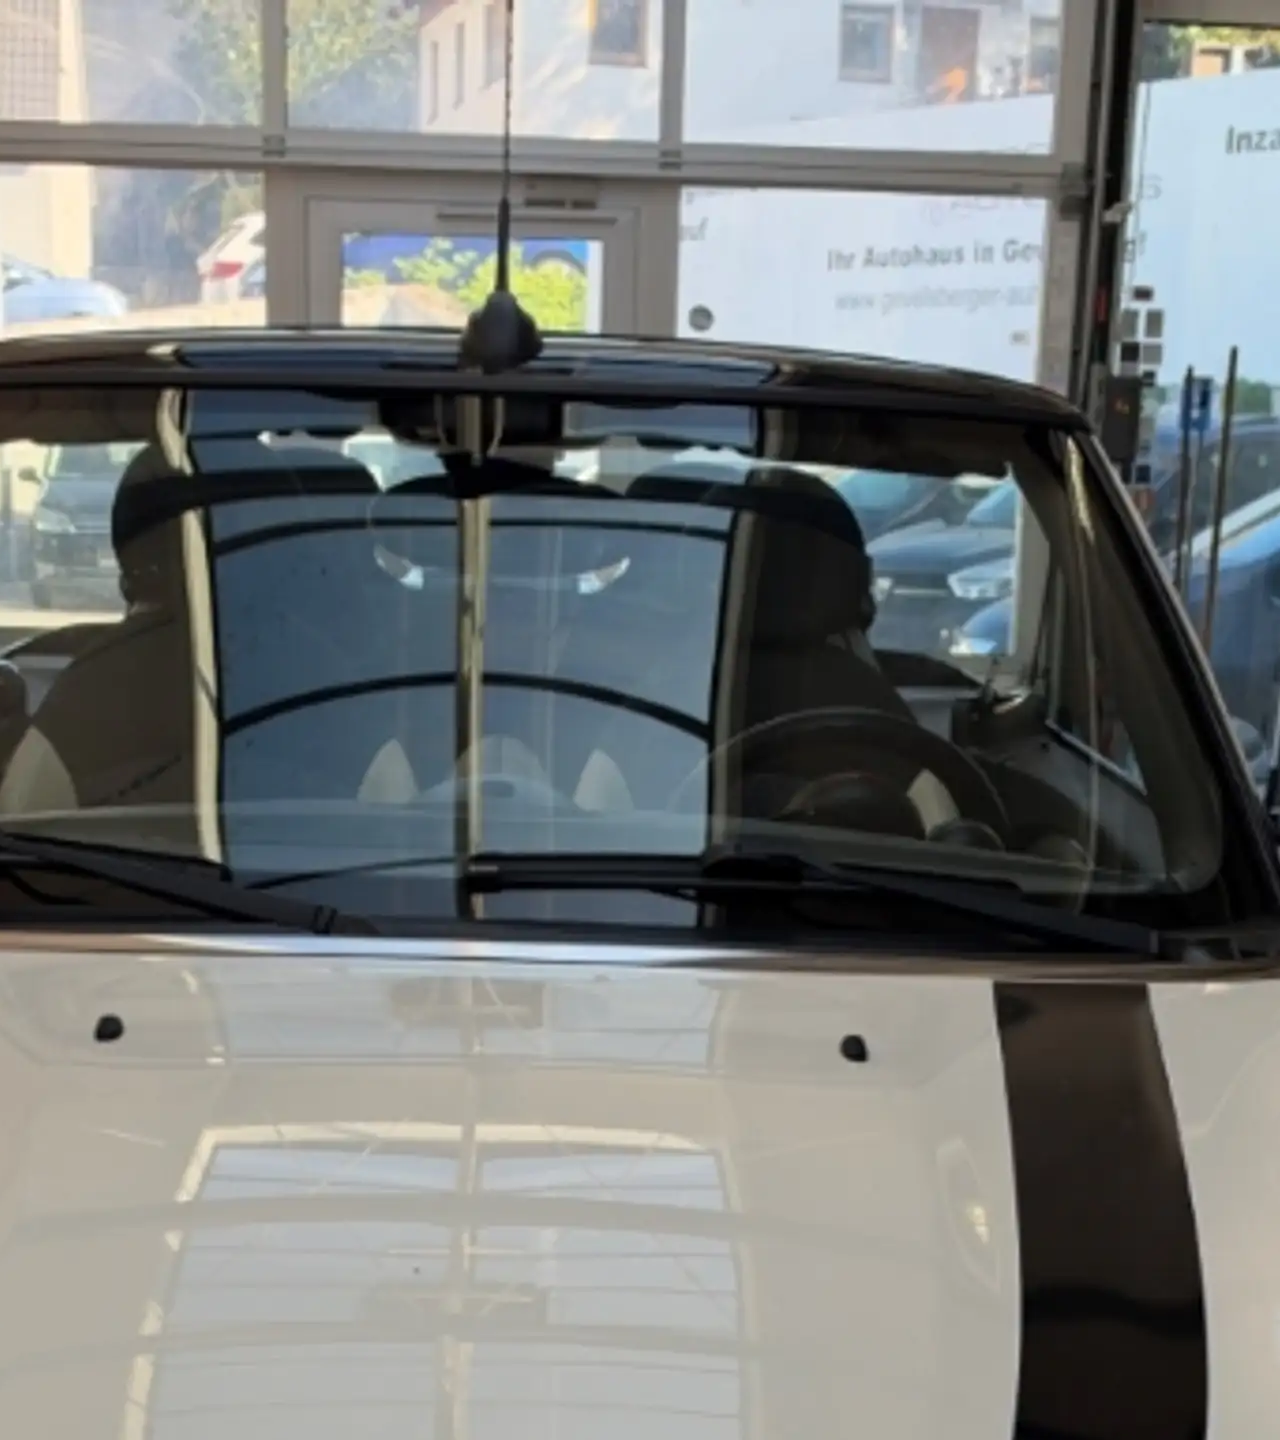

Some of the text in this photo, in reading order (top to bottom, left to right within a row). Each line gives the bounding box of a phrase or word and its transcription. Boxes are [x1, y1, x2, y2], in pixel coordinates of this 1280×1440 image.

[827, 248, 856, 271] Ihr
[862, 245, 965, 269] Autohaus
[973, 239, 995, 264] in
